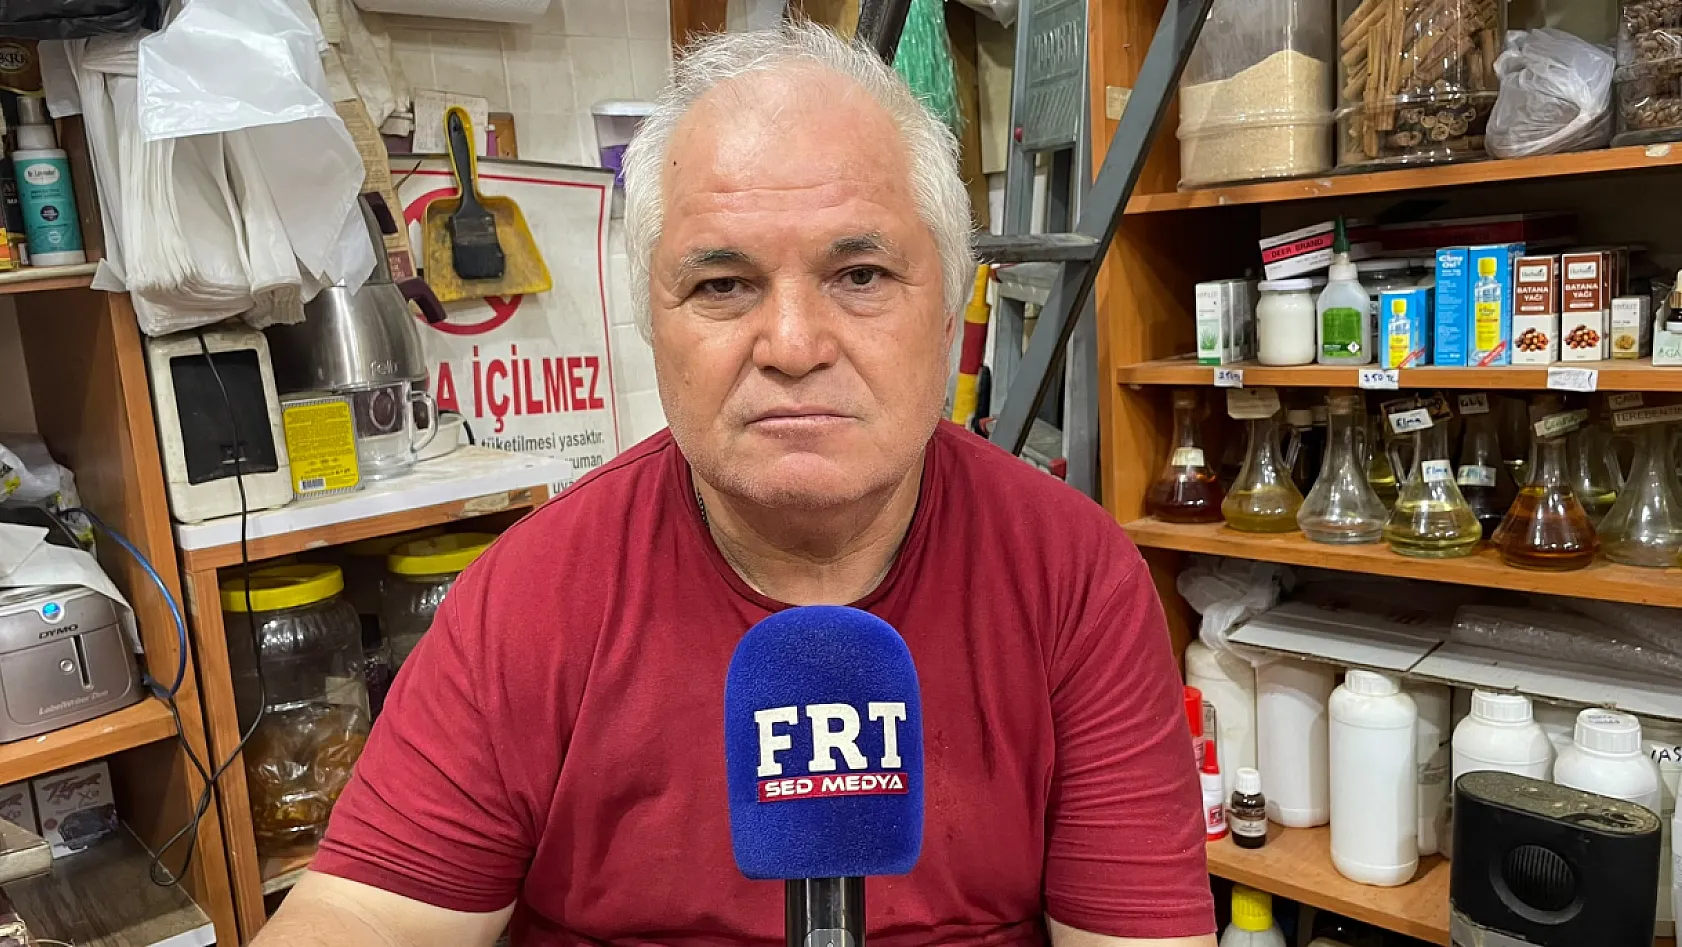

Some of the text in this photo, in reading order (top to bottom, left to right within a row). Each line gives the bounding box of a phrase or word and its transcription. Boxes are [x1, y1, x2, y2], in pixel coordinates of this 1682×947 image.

[472, 345, 605, 433] İÇİLMEZ
[39, 624, 78, 639] DYMO
[754, 702, 907, 778] FRT
[764, 774, 904, 798] SED MEDYA
